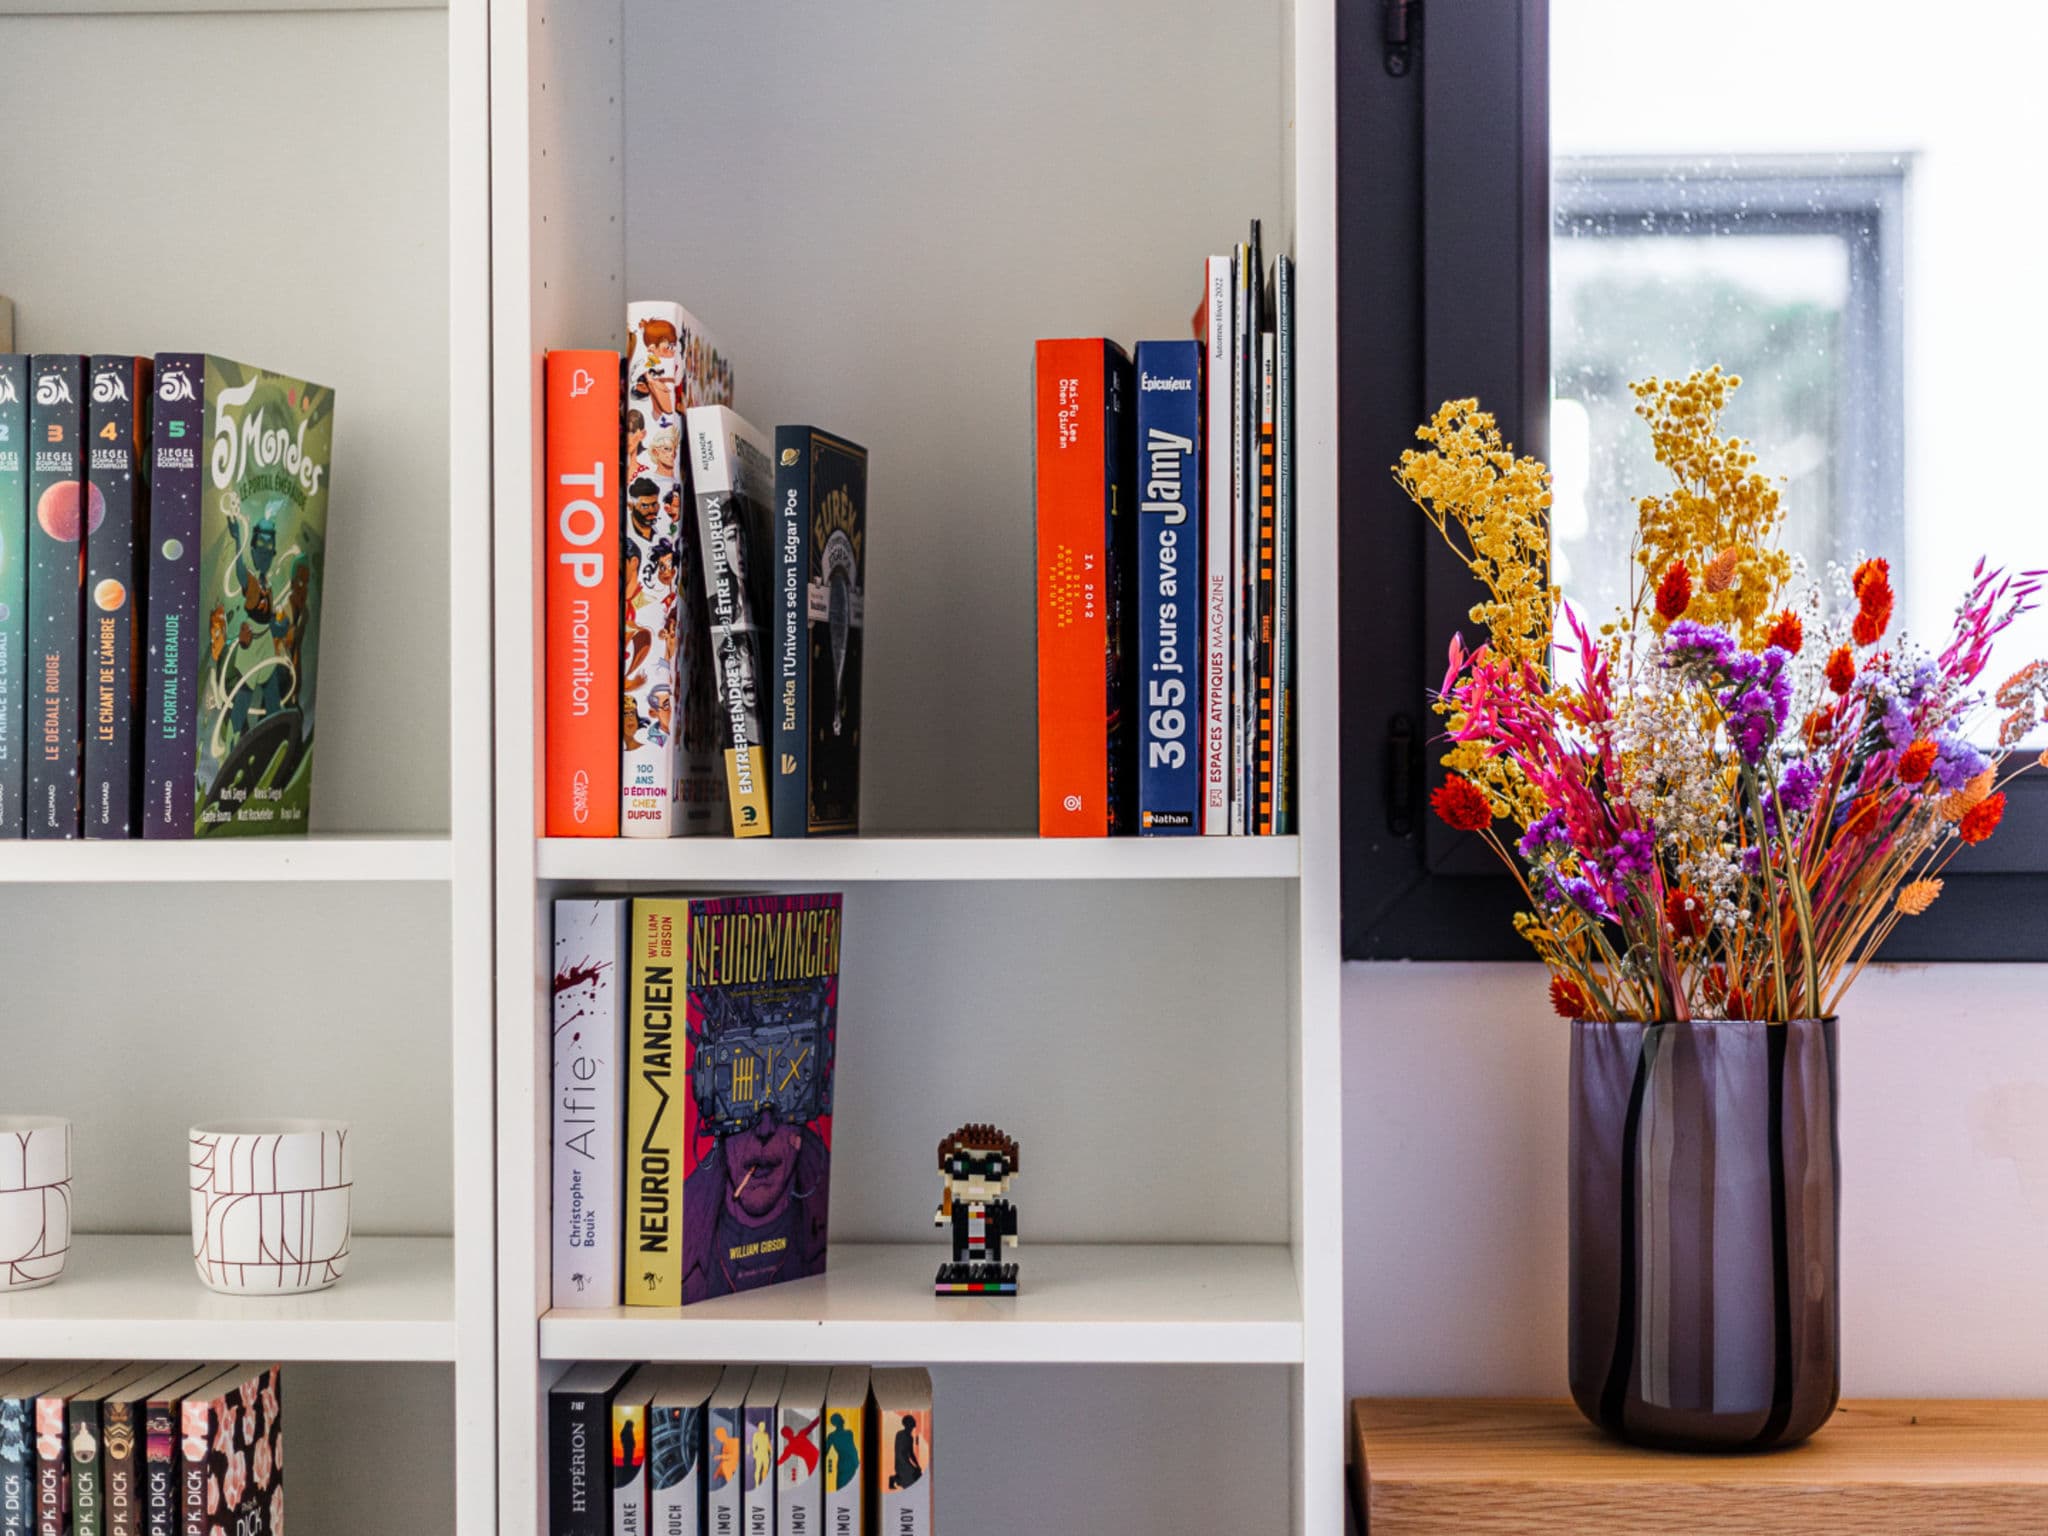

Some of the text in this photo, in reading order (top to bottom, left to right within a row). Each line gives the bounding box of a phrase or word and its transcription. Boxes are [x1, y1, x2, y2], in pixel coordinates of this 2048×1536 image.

[1058, 378, 1069, 449] Chen Qiufan
[1069, 378, 1079, 443] Kai-Fu Lee
[48, 425, 64, 442] 3
[99, 421, 117, 441] 4
[168, 420, 186, 438] 5
[212, 375, 324, 496] 5 Mondes
[36, 452, 73, 461] SIEGEL
[91, 449, 128, 459] SIEGEL
[157, 448, 194, 458] SIEGEL
[707, 497, 729, 574] HEUREUX
[560, 461, 605, 716] TOP marmiton
[715, 578, 732, 615] ÊTRE
[1084, 583, 1094, 619] 2042
[1141, 427, 1193, 769] 365 jours avec Jamy
[782, 488, 800, 731] Eurêka l'Univers selon Edgar Poe
[1211, 575, 1225, 649] MAGAZINE
[99, 617, 116, 741] LE CHANT DE L'AMBRE
[161, 614, 180, 739] LE PORTAIL ÉMERAUDE
[1210, 652, 1223, 724] ATYPIQUES
[43, 654, 60, 761] LE DÉDALE ROUGE
[726, 667, 753, 794] ENTREPRENDRE
[637, 764, 653, 773] 100
[1210, 726, 1223, 783] ESPACES
[635, 776, 654, 784] ANS
[101, 781, 110, 824] GALLIMARD
[164, 780, 172, 823] GALLIMARD
[628, 810, 662, 819] DUPUIS
[632, 799, 656, 808] CHEZ
[1150, 814, 1189, 824] Nathan
[648, 913, 658, 958] WILLIAM
[661, 916, 672, 957] GIBSON
[692, 908, 841, 986] NEUROMANCIEN
[563, 1057, 596, 1160] Alfie
[570, 1169, 584, 1247] Christopher
[583, 1210, 595, 1248] Bouix
[729, 1237, 787, 1260] WILLIAM GIBSON
[570, 1422, 586, 1512] HYPÉRION
[5, 1475, 19, 1510] DICK
[42, 1468, 57, 1504] DICK
[78, 1472, 93, 1507] DICK
[113, 1471, 127, 1507] DICK
[151, 1472, 166, 1507] DICK
[187, 1470, 202, 1505] DICK
[5, 1513, 19, 1526] K.
[42, 1507, 57, 1520] K.
[78, 1510, 93, 1523] K.
[113, 1510, 127, 1523] K.
[151, 1510, 166, 1523] K.
[187, 1508, 202, 1521] K.
[623, 1503, 637, 1536] ARKE
